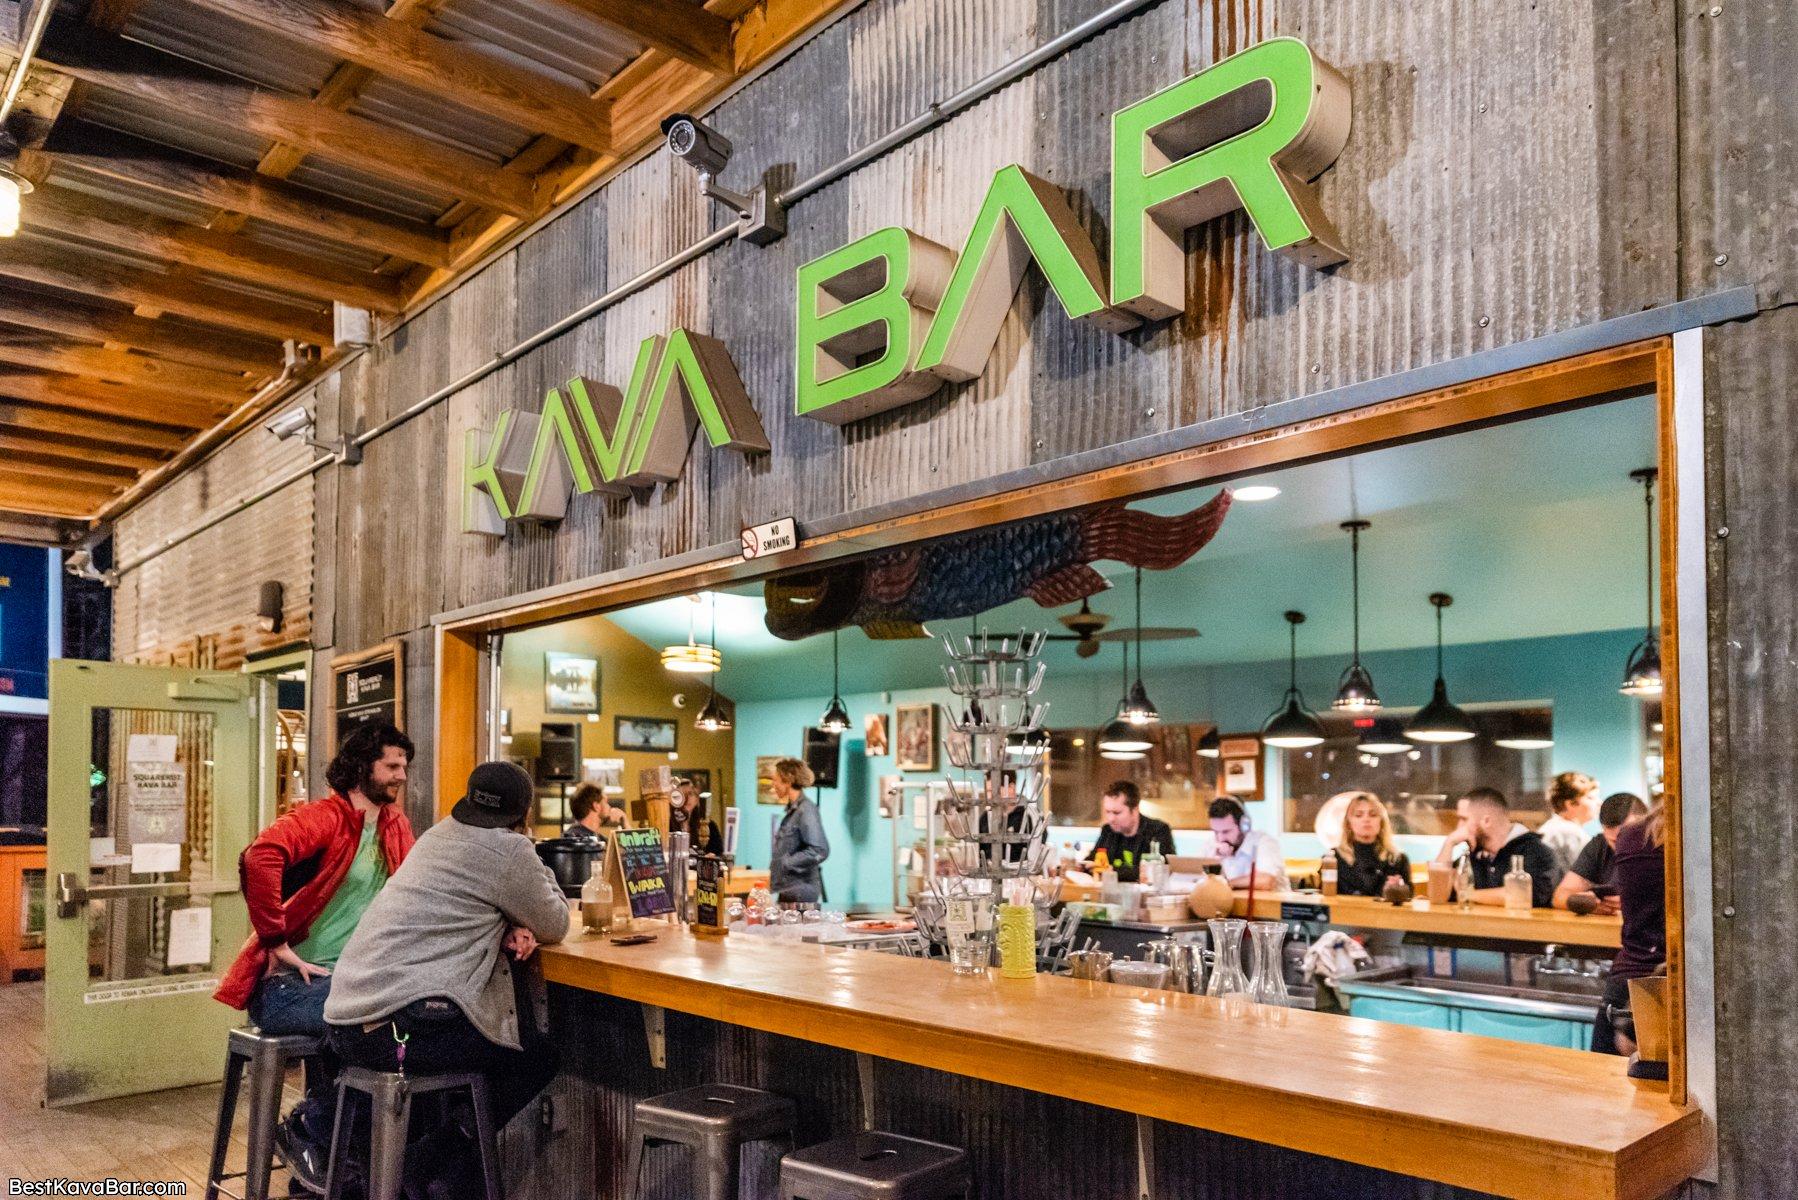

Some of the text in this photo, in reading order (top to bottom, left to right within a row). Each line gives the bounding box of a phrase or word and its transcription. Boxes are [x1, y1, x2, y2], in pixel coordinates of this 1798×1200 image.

[463, 36, 1314, 534] KAVA BAR
[771, 525, 779, 535] NO
[763, 536, 790, 550] SMOKING
